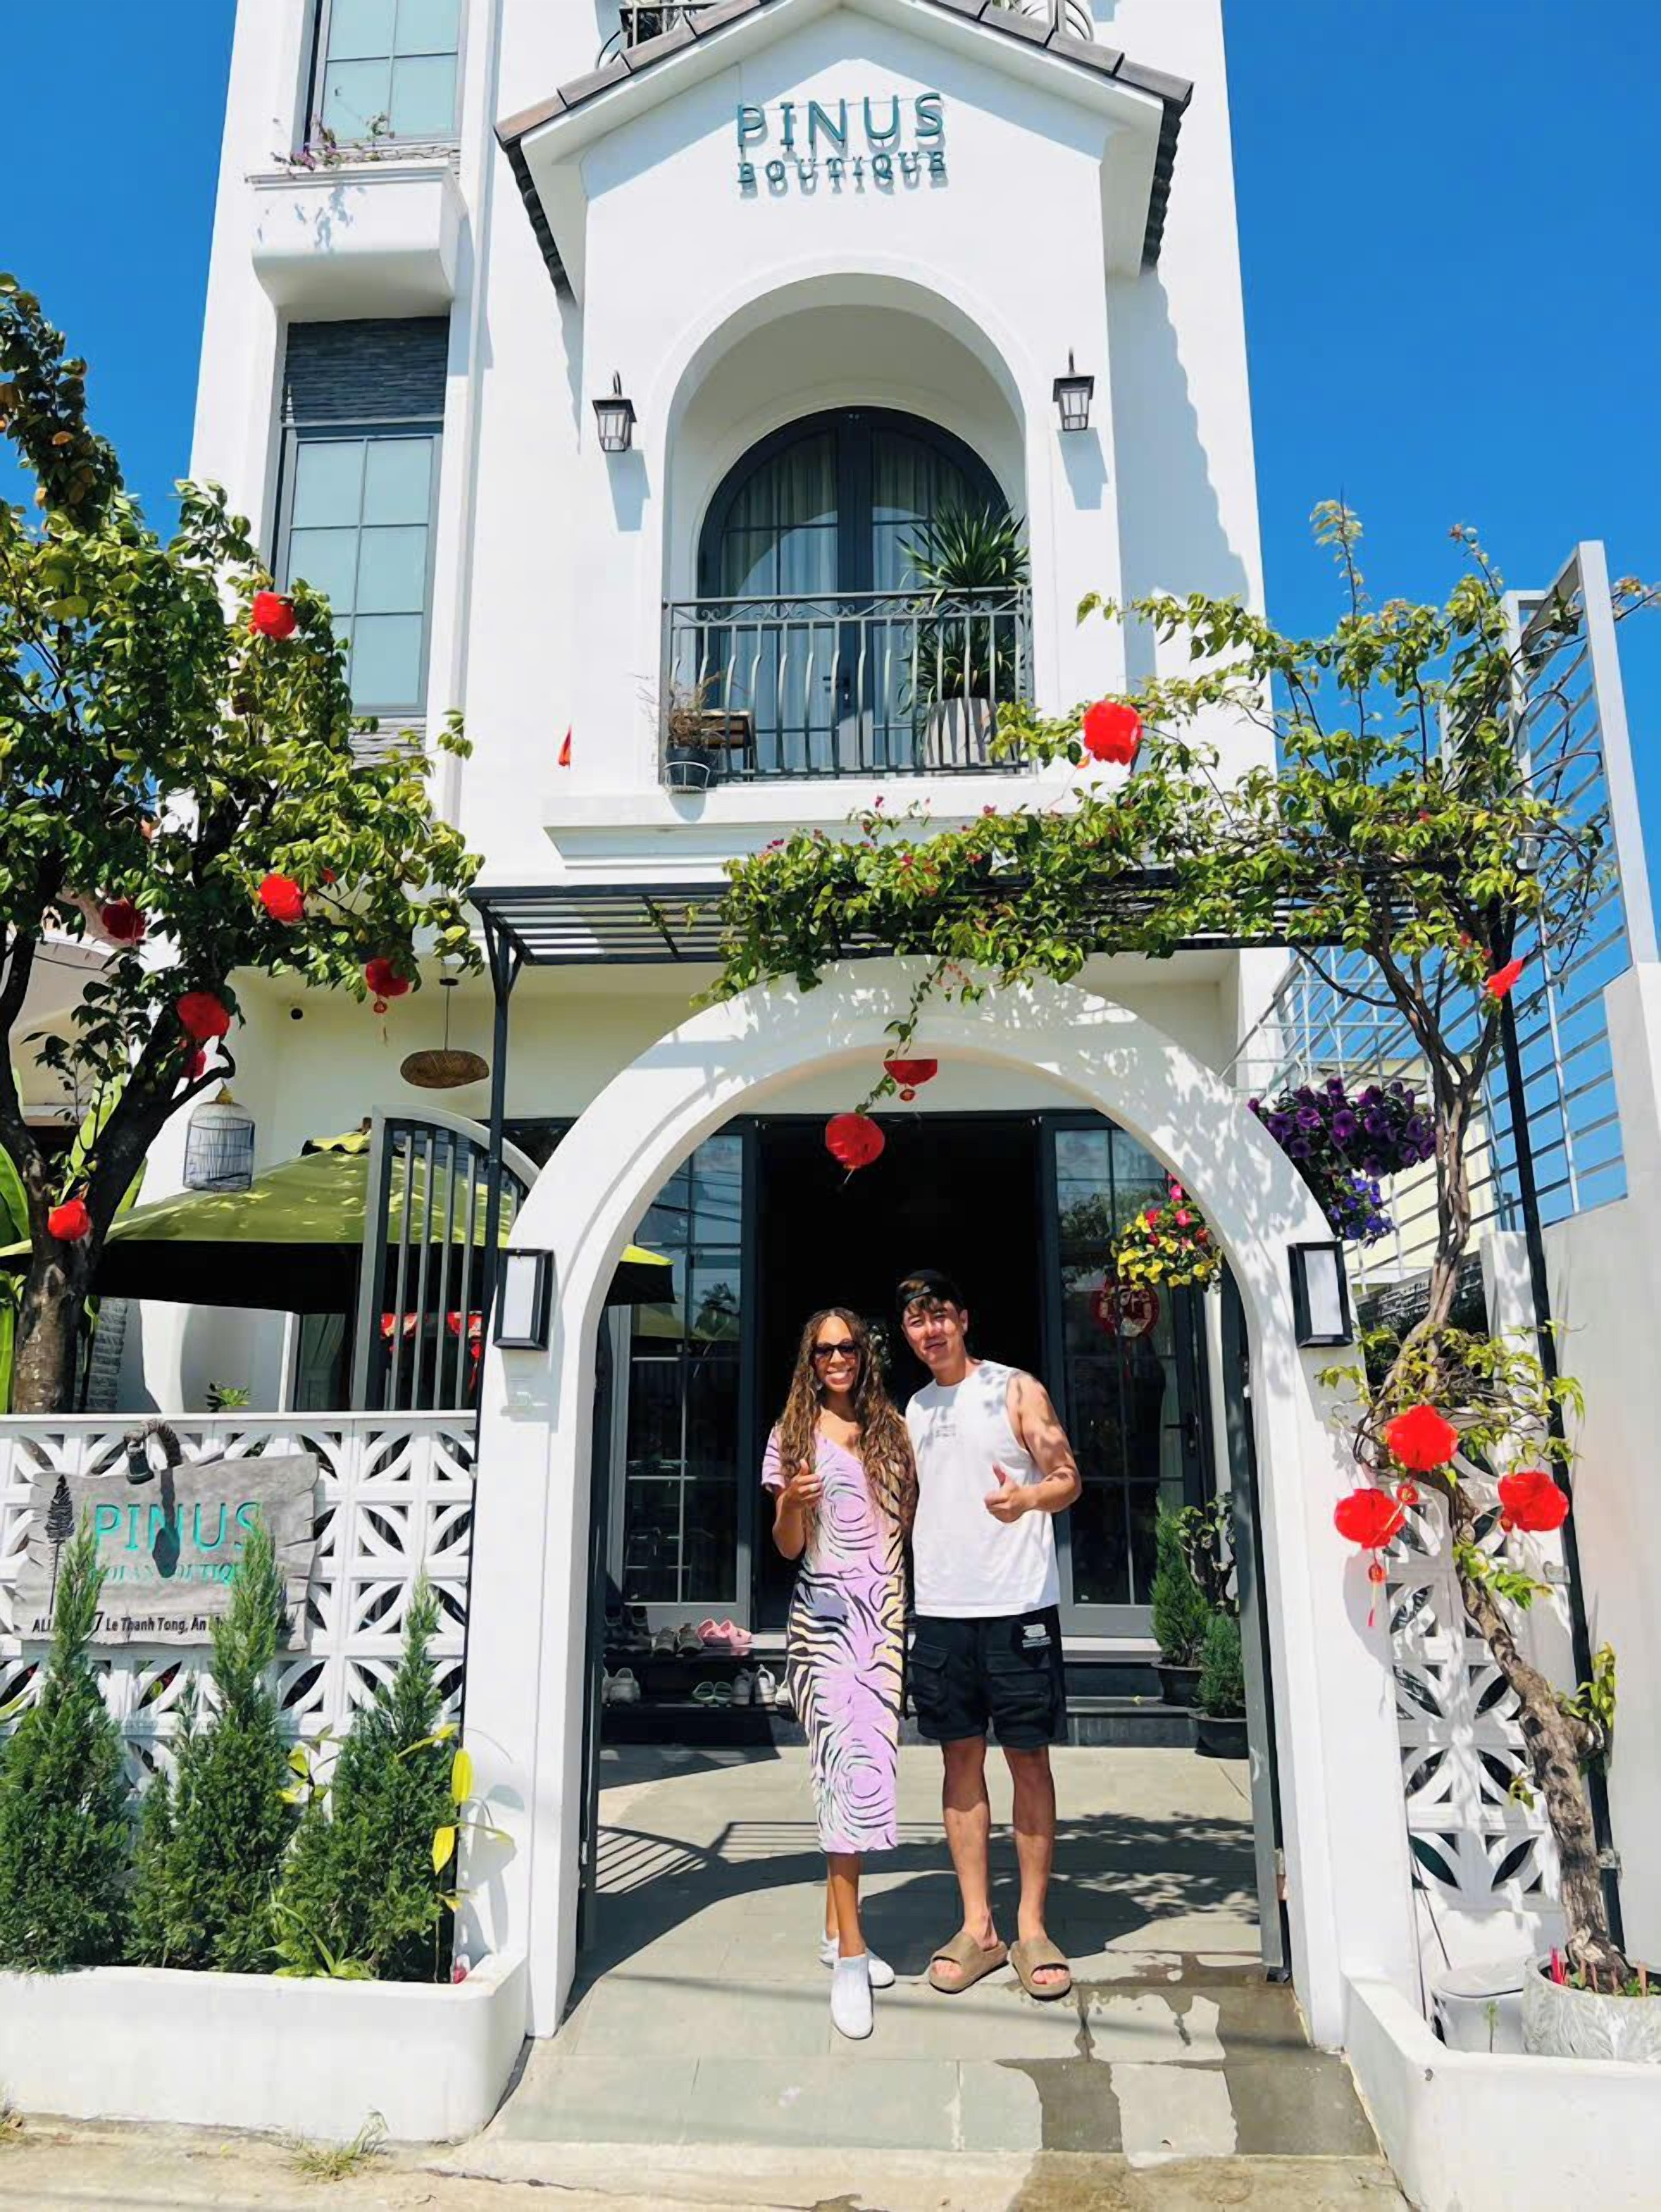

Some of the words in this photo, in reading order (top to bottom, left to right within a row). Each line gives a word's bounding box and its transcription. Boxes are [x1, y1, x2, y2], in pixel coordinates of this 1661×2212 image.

[737, 92, 943, 147] PINUS
[738, 151, 946, 183] BOUTIQUE
[96, 1502, 260, 1551] PINUS
[106, 1617, 118, 1631] Le
[121, 1617, 155, 1631] Thanh
